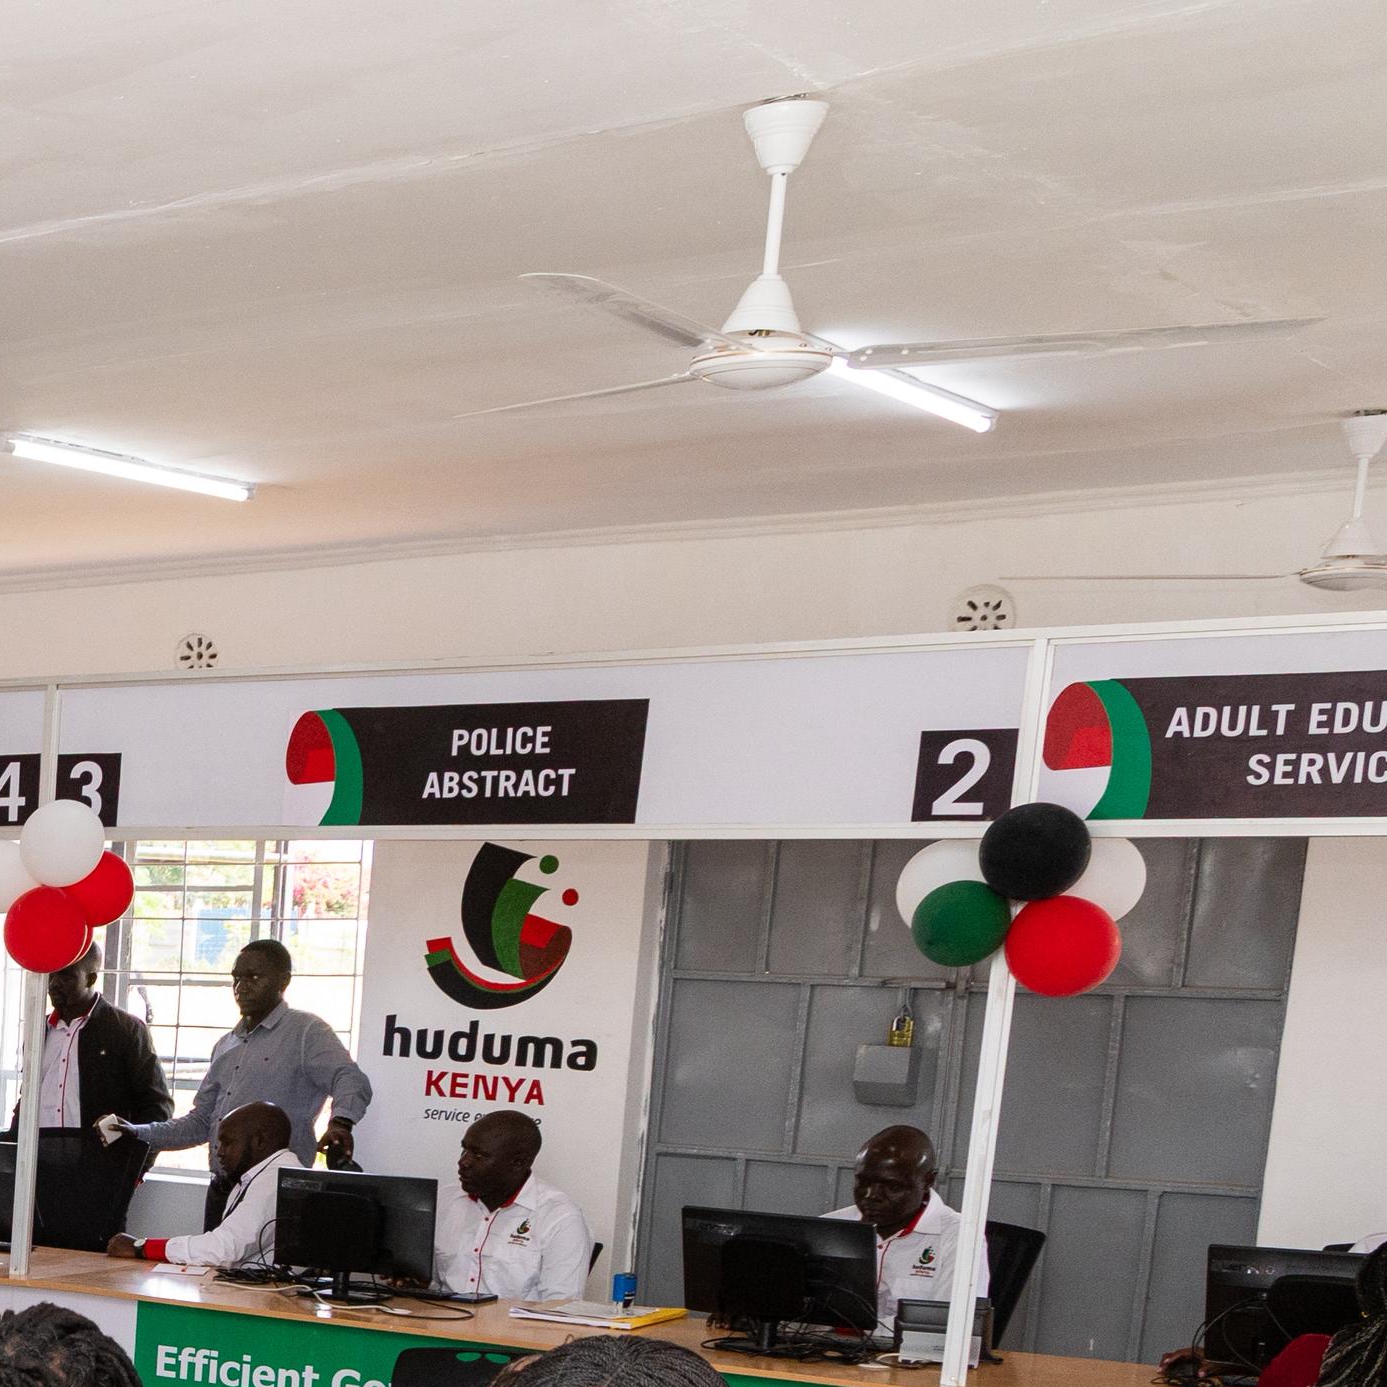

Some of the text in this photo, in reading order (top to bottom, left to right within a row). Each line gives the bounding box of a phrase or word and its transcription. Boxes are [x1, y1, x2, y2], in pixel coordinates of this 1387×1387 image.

[1165, 701, 1387, 738] ADULT EDU
[451, 725, 552, 756] POLICE
[422, 768, 576, 798] ABSTRACT
[931, 738, 991, 816] 2
[1245, 751, 1387, 785] SERVIC
[69, 760, 103, 817] 3
[382, 1014, 598, 1072] huduma
[425, 1070, 545, 1106] KENYA
[423, 1108, 470, 1123] service
